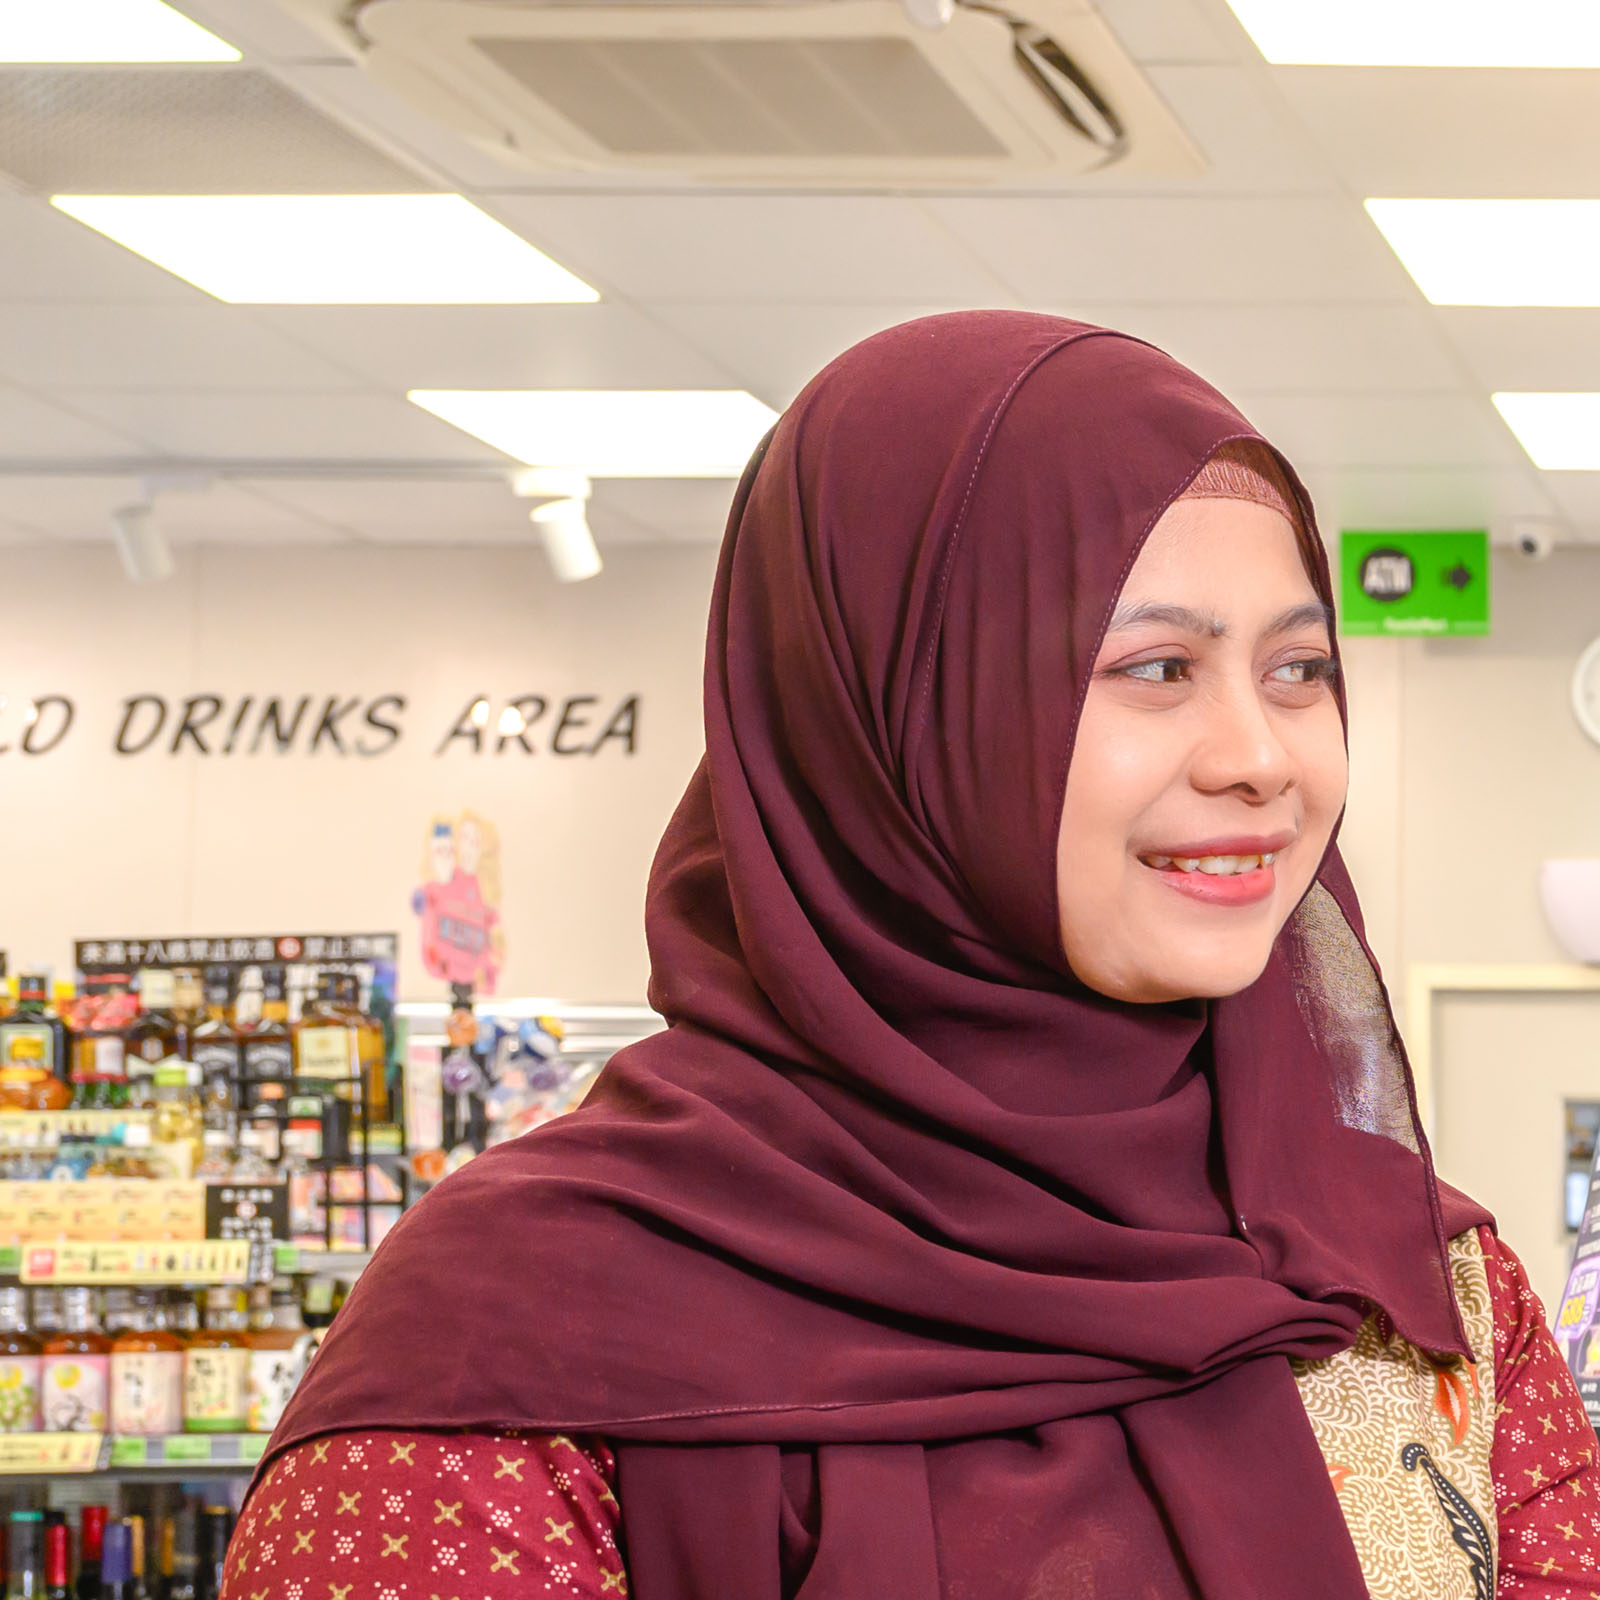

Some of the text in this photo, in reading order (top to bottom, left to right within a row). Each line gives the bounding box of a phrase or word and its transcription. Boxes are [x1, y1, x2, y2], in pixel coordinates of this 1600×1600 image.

[0, 694, 643, 757] D DRINKS AREA
